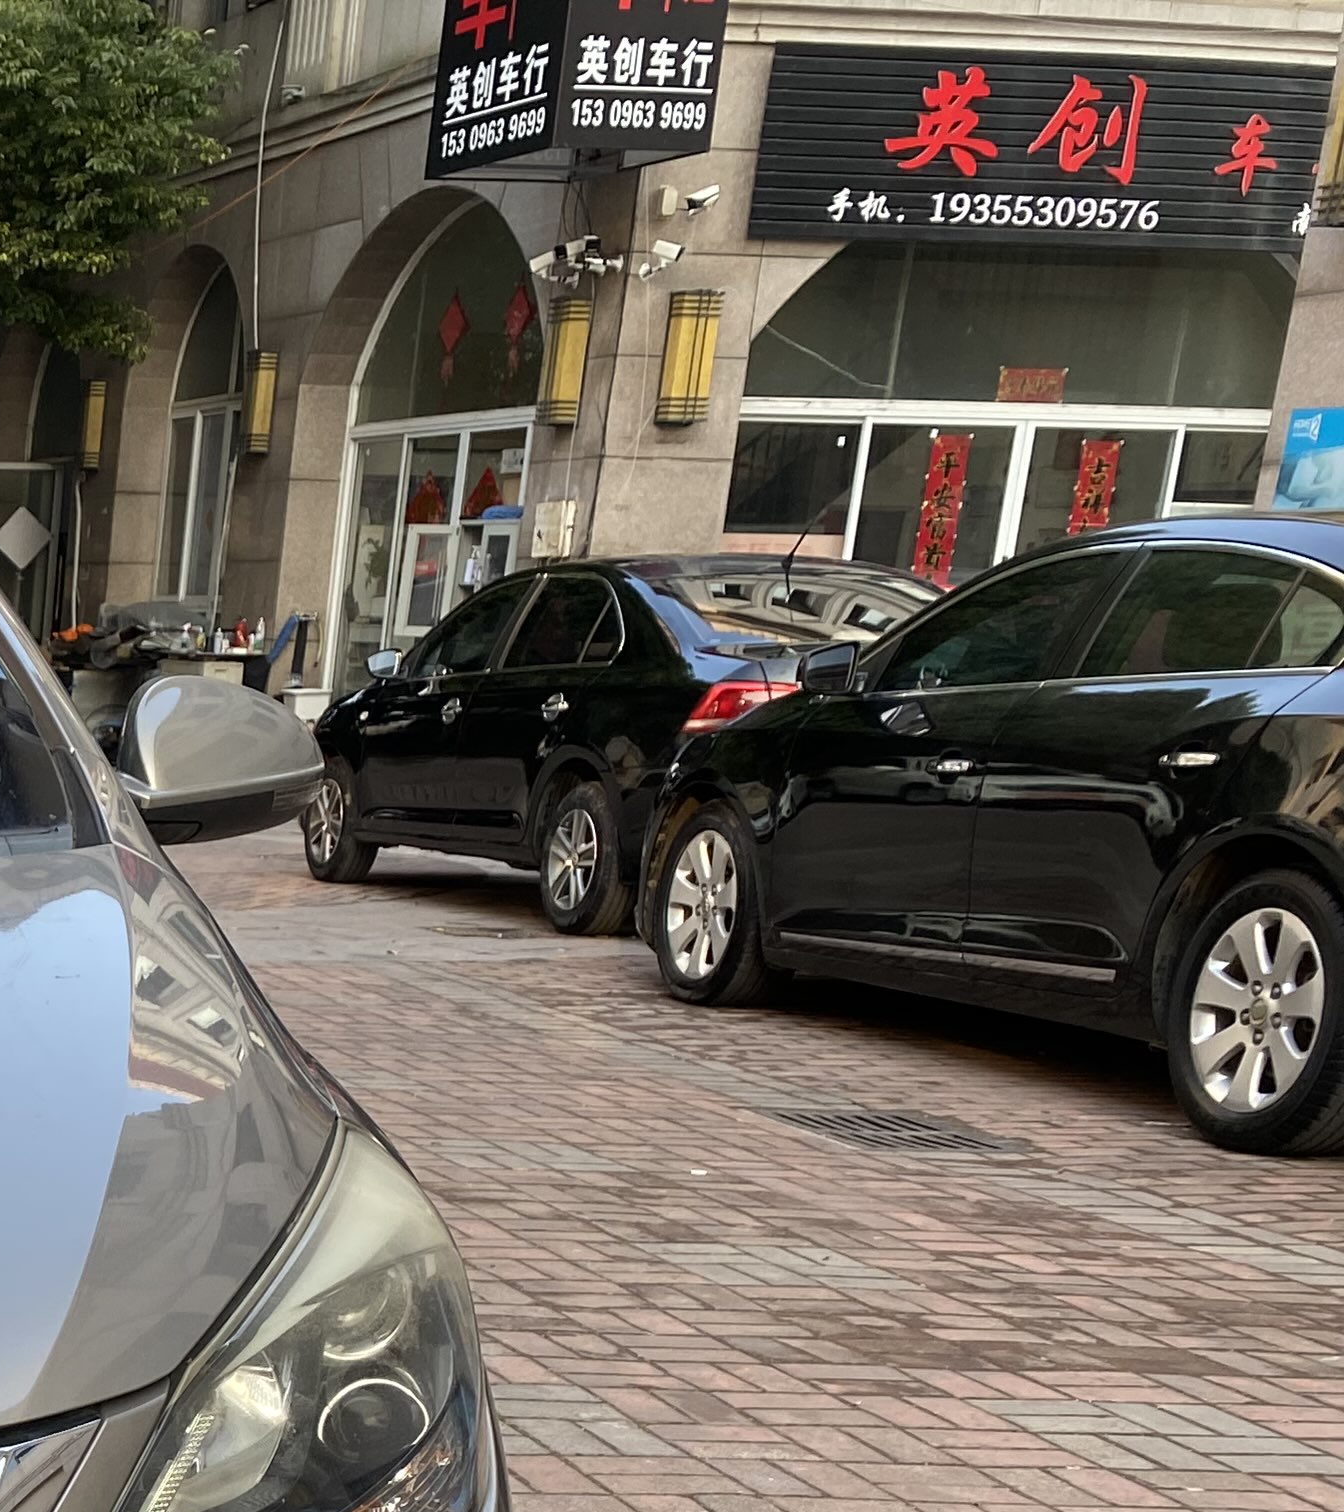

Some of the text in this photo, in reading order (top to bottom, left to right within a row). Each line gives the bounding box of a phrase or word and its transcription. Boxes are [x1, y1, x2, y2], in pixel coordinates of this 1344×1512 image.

[445, 42, 550, 118] 英创车行
[576, 34, 714, 87] 英创车行
[441, 106, 546, 159] 153 0963 9699
[571, 98, 706, 131] 153 0963 9699
[885, 66, 1319, 196] 英创车
[929, 192, 1160, 230] 19355309576
